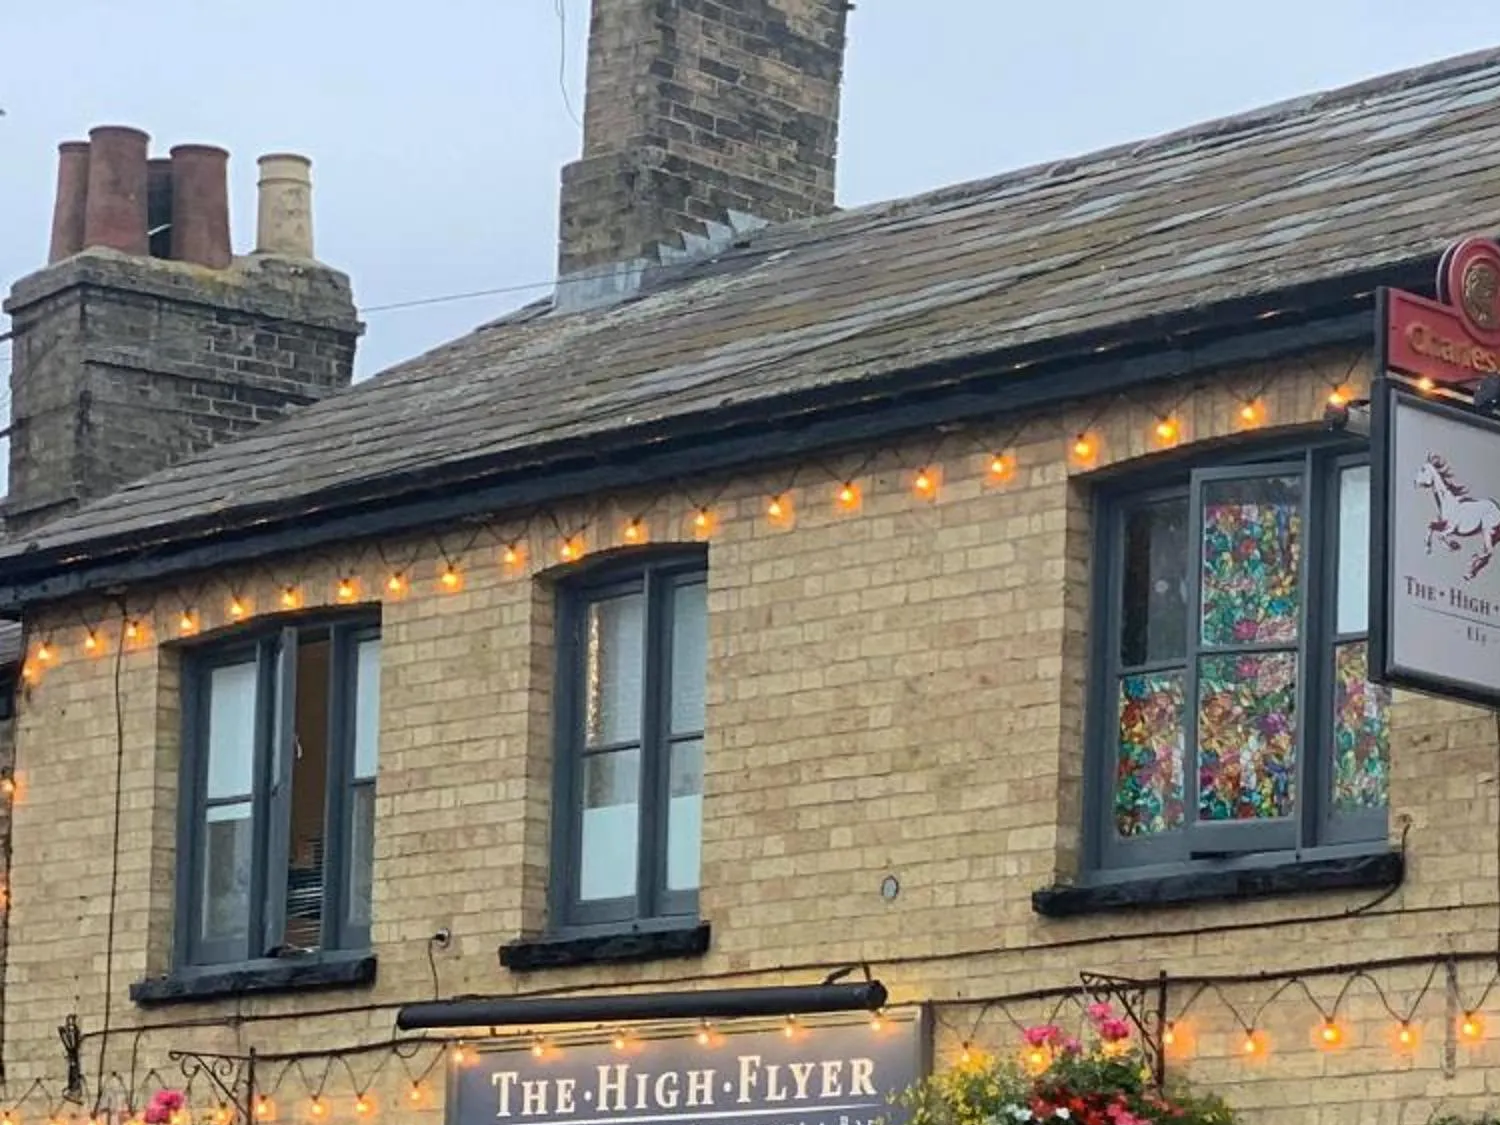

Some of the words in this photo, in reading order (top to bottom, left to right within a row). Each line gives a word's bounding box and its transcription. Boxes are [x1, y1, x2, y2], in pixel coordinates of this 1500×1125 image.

[1404, 576, 1436, 601] THE
[1450, 587, 1491, 616] HIGH
[491, 1071, 576, 1118] THE
[597, 1063, 715, 1112] HIGH
[736, 1054, 878, 1103] FLYER
